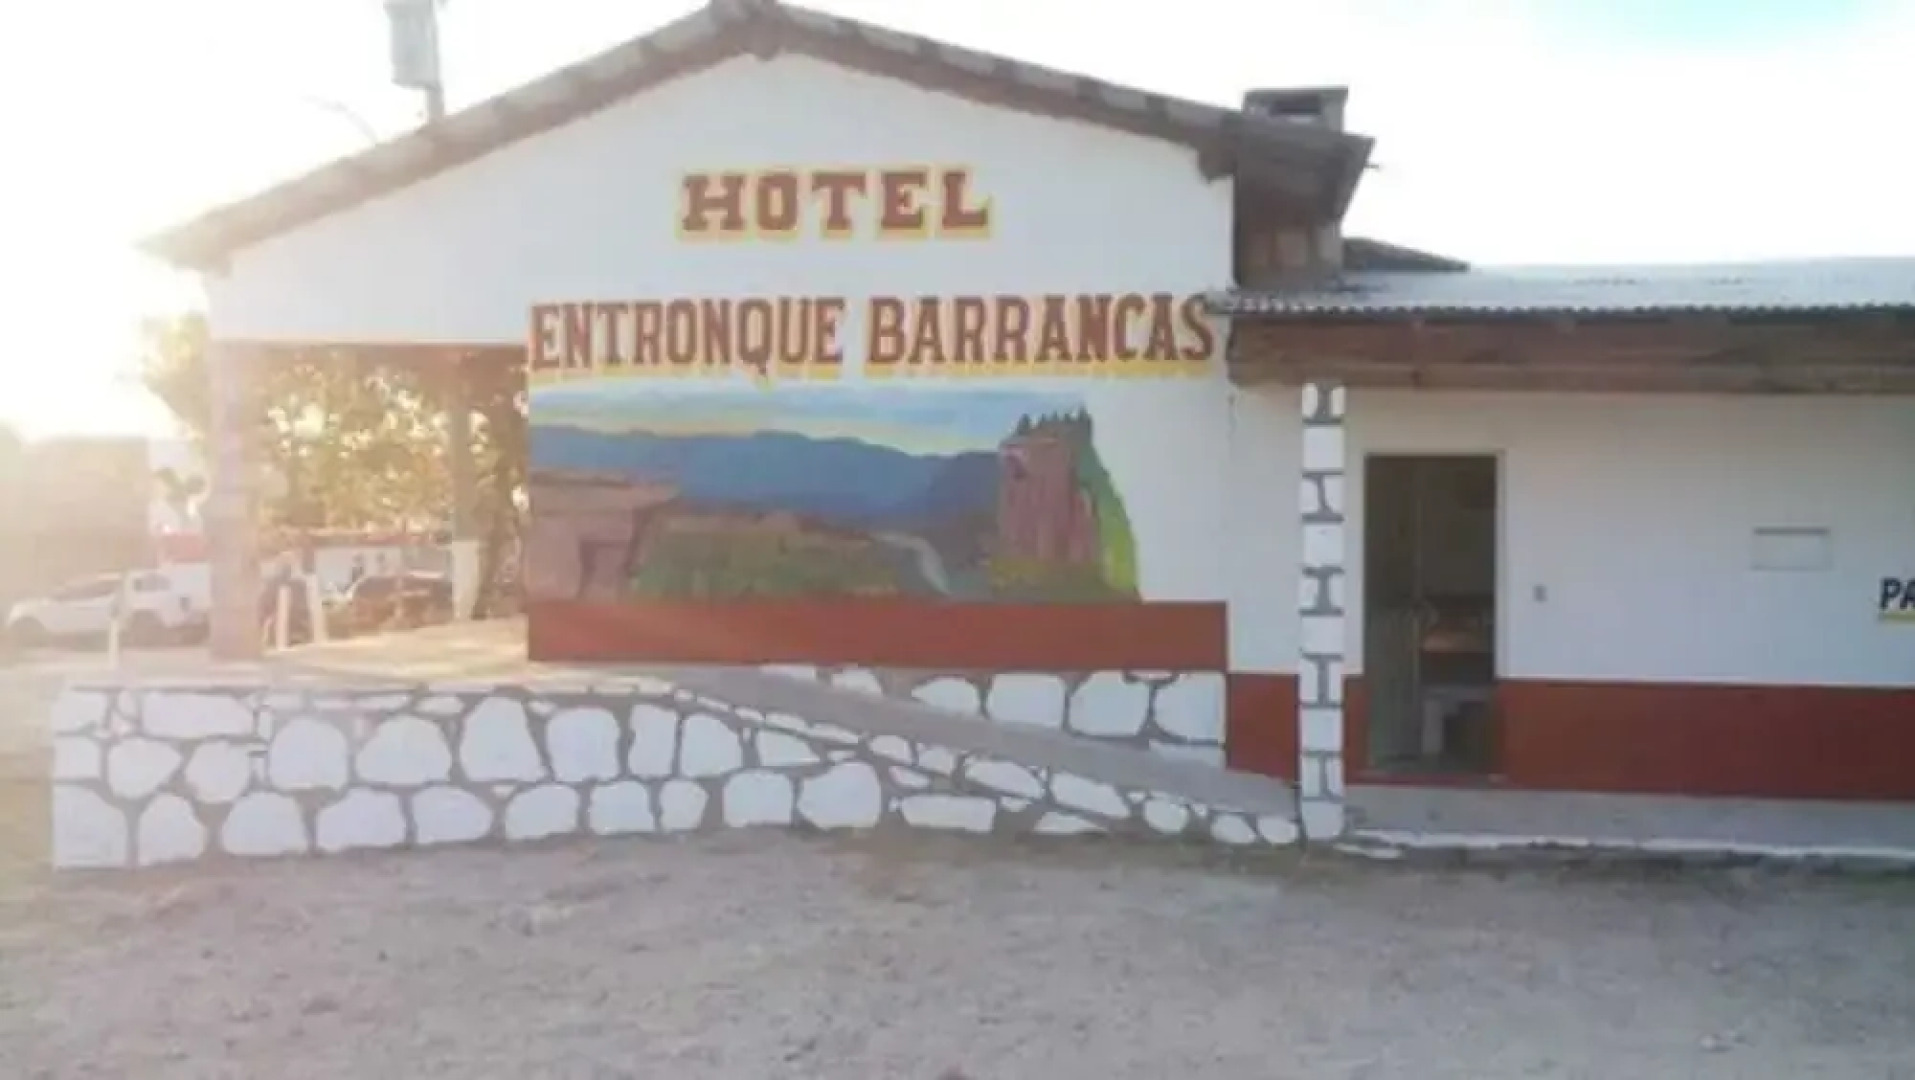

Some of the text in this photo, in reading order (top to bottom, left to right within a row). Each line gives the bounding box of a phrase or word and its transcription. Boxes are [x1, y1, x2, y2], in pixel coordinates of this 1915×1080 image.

[680, 169, 990, 233] HOTEL
[531, 293, 1215, 376] ENTRONQUE BARRANCAS
